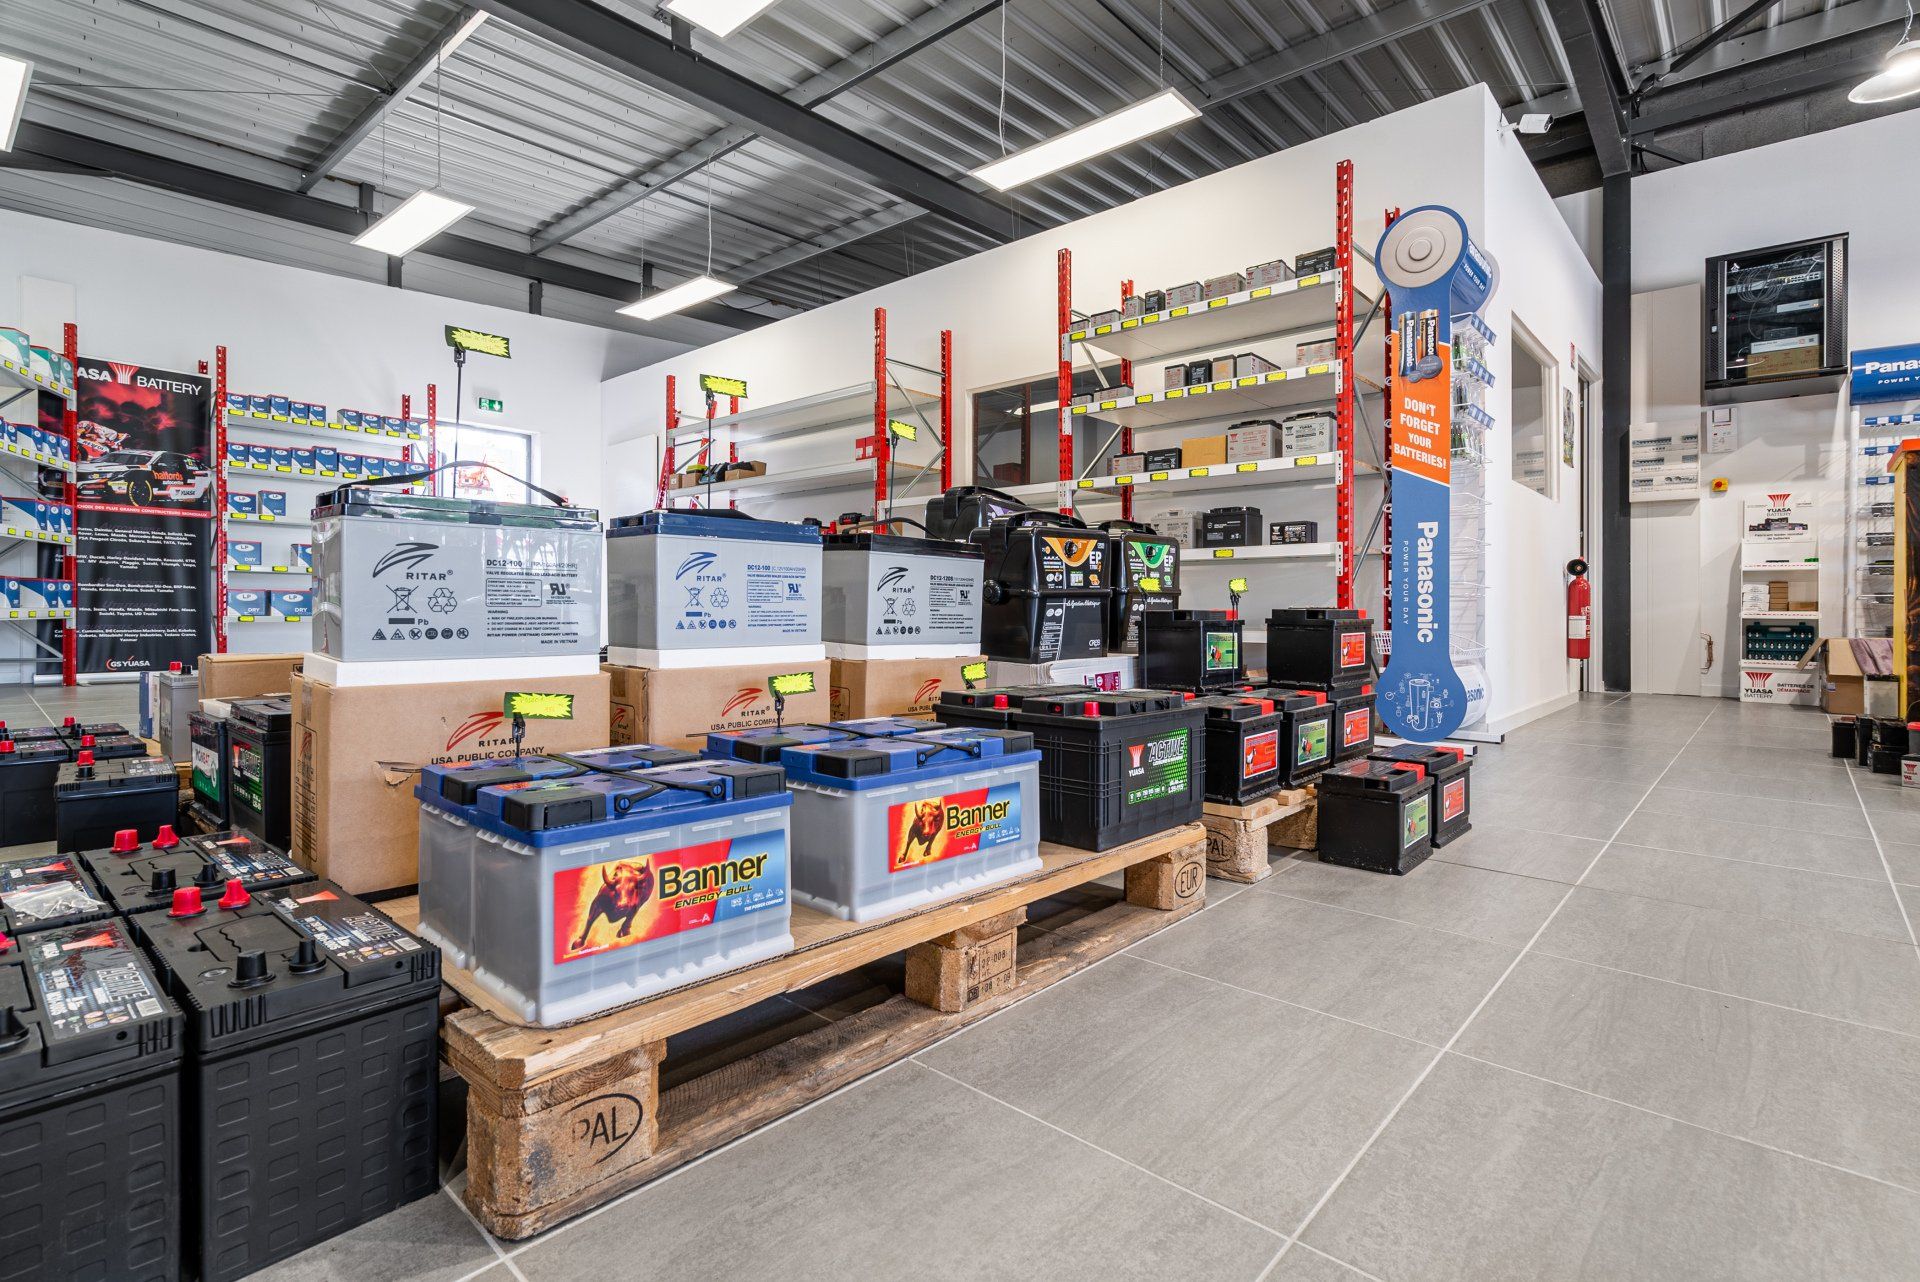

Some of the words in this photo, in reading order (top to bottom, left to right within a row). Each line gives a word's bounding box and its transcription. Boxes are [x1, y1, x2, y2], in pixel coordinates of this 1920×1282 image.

[1406, 320, 1414, 367] Panasonic
[1865, 360, 1920, 374] Pana
[76, 366, 112, 382] ASA
[137, 375, 202, 396] BATTERY
[1400, 412, 1440, 435] FORGET
[1408, 432, 1432, 449] YOUR
[1394, 443, 1447, 470] BATTERIES!
[406, 572, 446, 580] RITAR
[1417, 521, 1439, 643] Panasonic
[1467, 684, 1485, 703] asonic
[741, 708, 766, 716] RITAR
[727, 720, 752, 729] PUBLIC
[754, 717, 784, 727] COMPAY
[478, 738, 515, 747] RITAR
[431, 756, 452, 765] USA
[457, 752, 494, 763] PUBLIC
[1128, 767, 1144, 777] YUASA
[946, 800, 1010, 830] Banner
[956, 828, 983, 838] ENERGY
[658, 852, 768, 900] Banner
[1181, 867, 1198, 894] EUR
[675, 891, 722, 909] ENERGY
[725, 884, 752, 897] BULL
